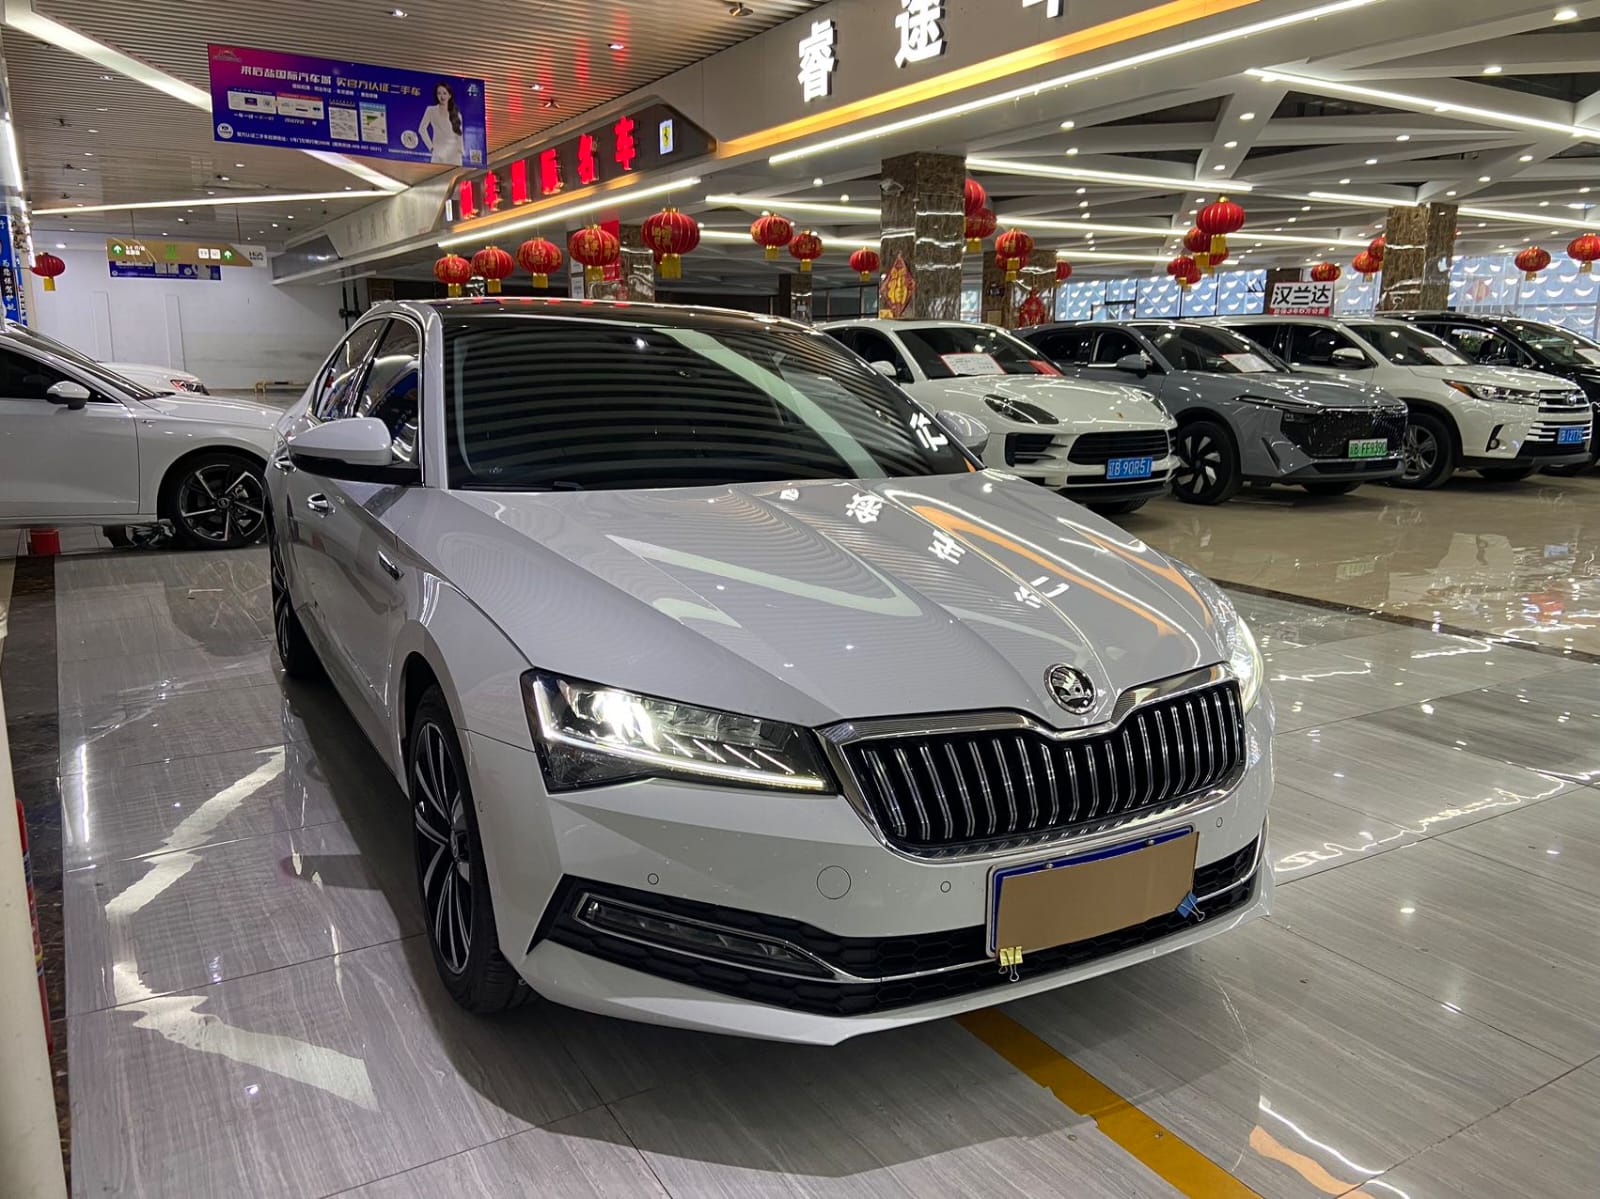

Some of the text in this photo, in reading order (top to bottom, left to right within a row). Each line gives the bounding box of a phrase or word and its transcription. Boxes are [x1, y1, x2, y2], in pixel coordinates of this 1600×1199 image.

[798, 0, 1059, 102] 睿途
[1272, 284, 1331, 305] 汉兰达
